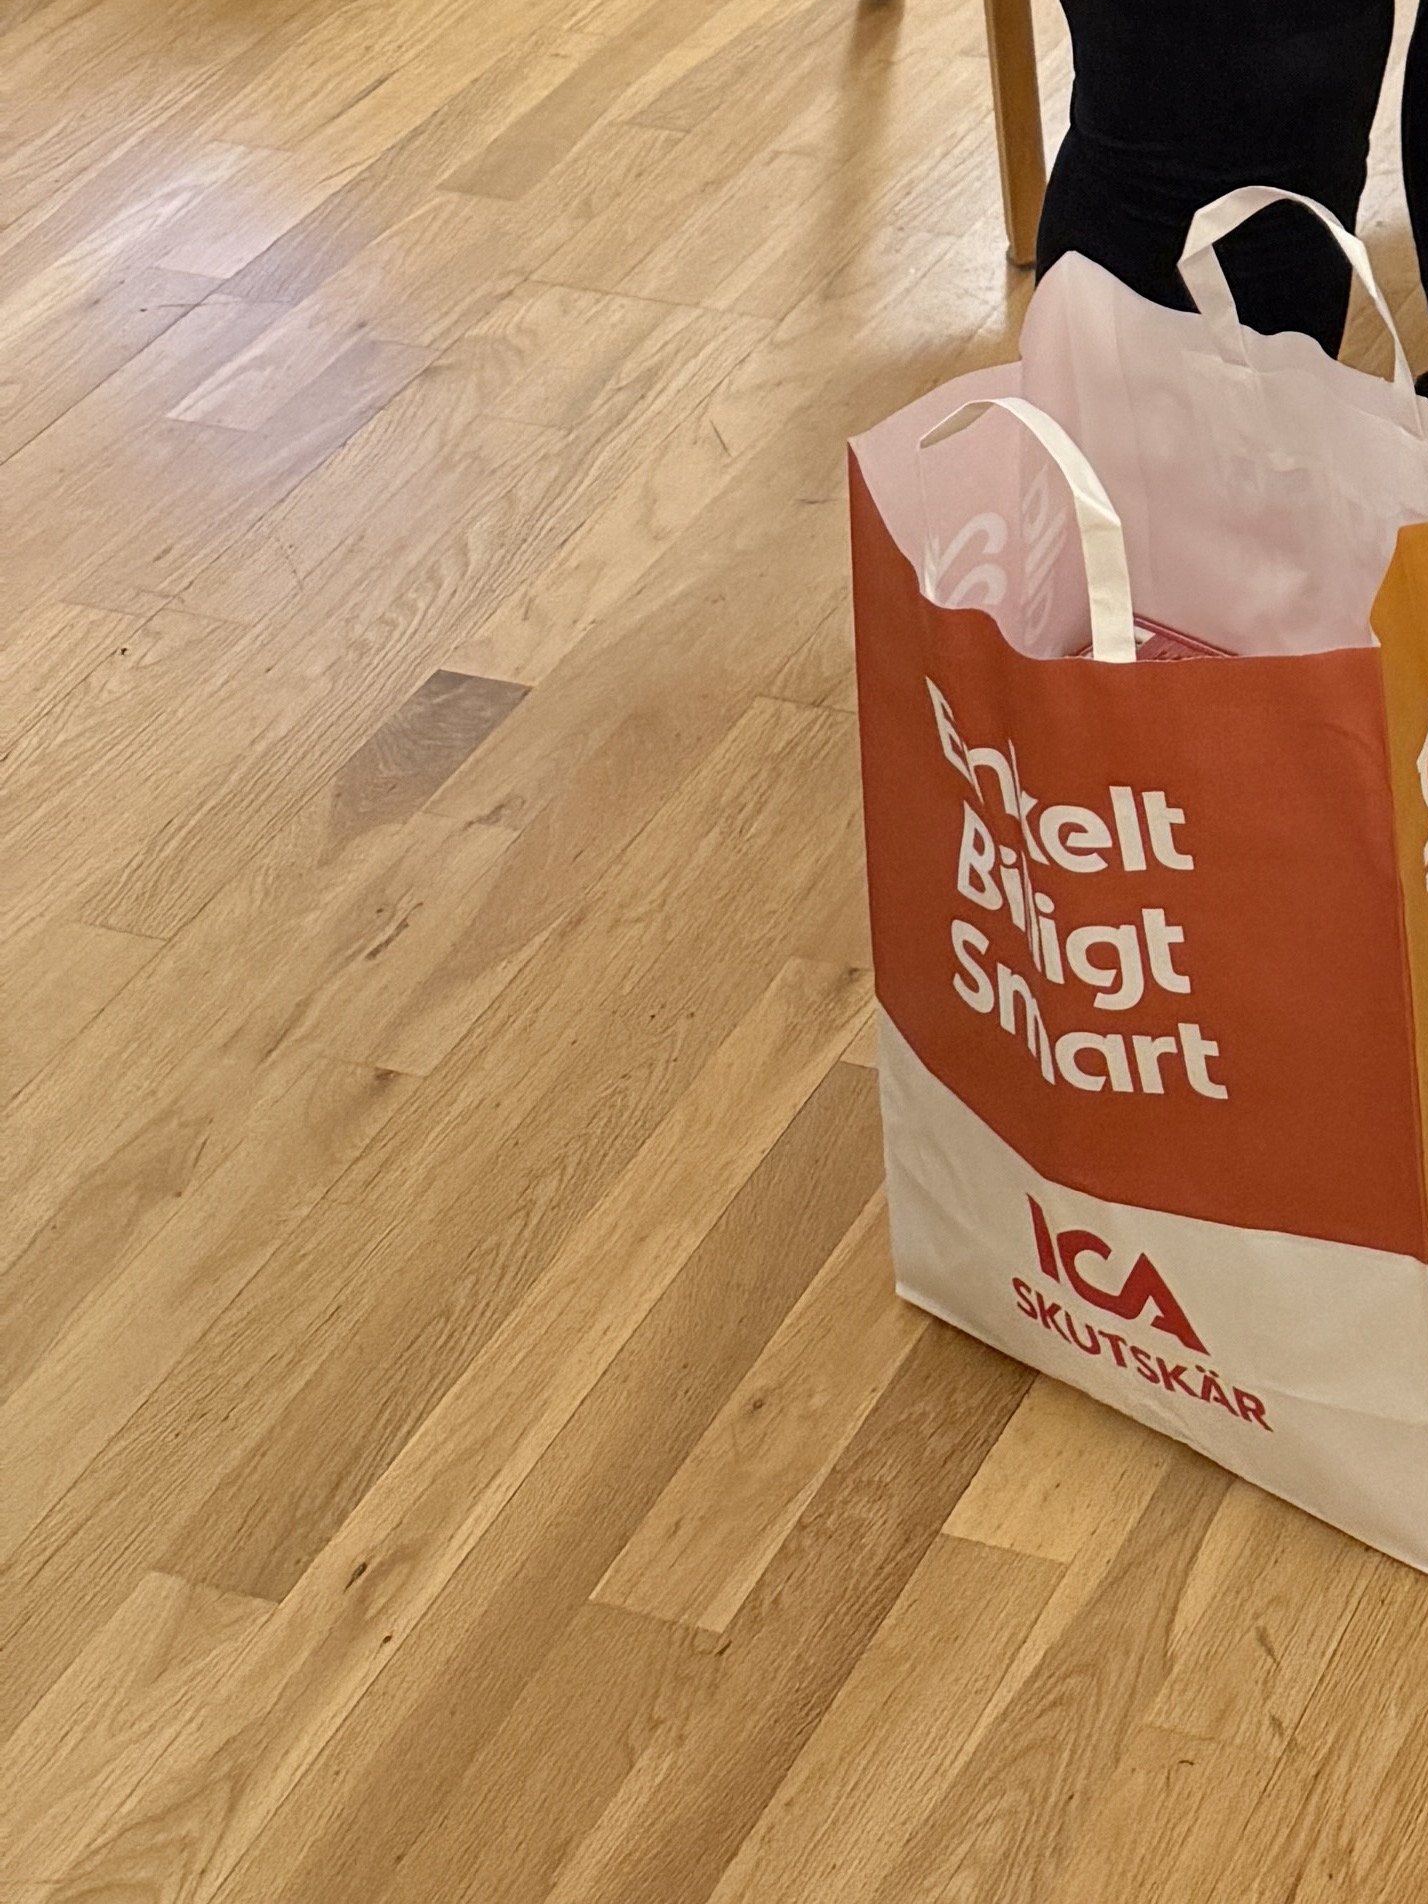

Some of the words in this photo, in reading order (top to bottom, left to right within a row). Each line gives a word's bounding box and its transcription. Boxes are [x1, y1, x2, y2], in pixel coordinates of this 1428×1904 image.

[951, 919, 1229, 1100] Smart
[1012, 1276, 1275, 1433] SKUTSKÄR
[1026, 1192, 1211, 1357] ICA
